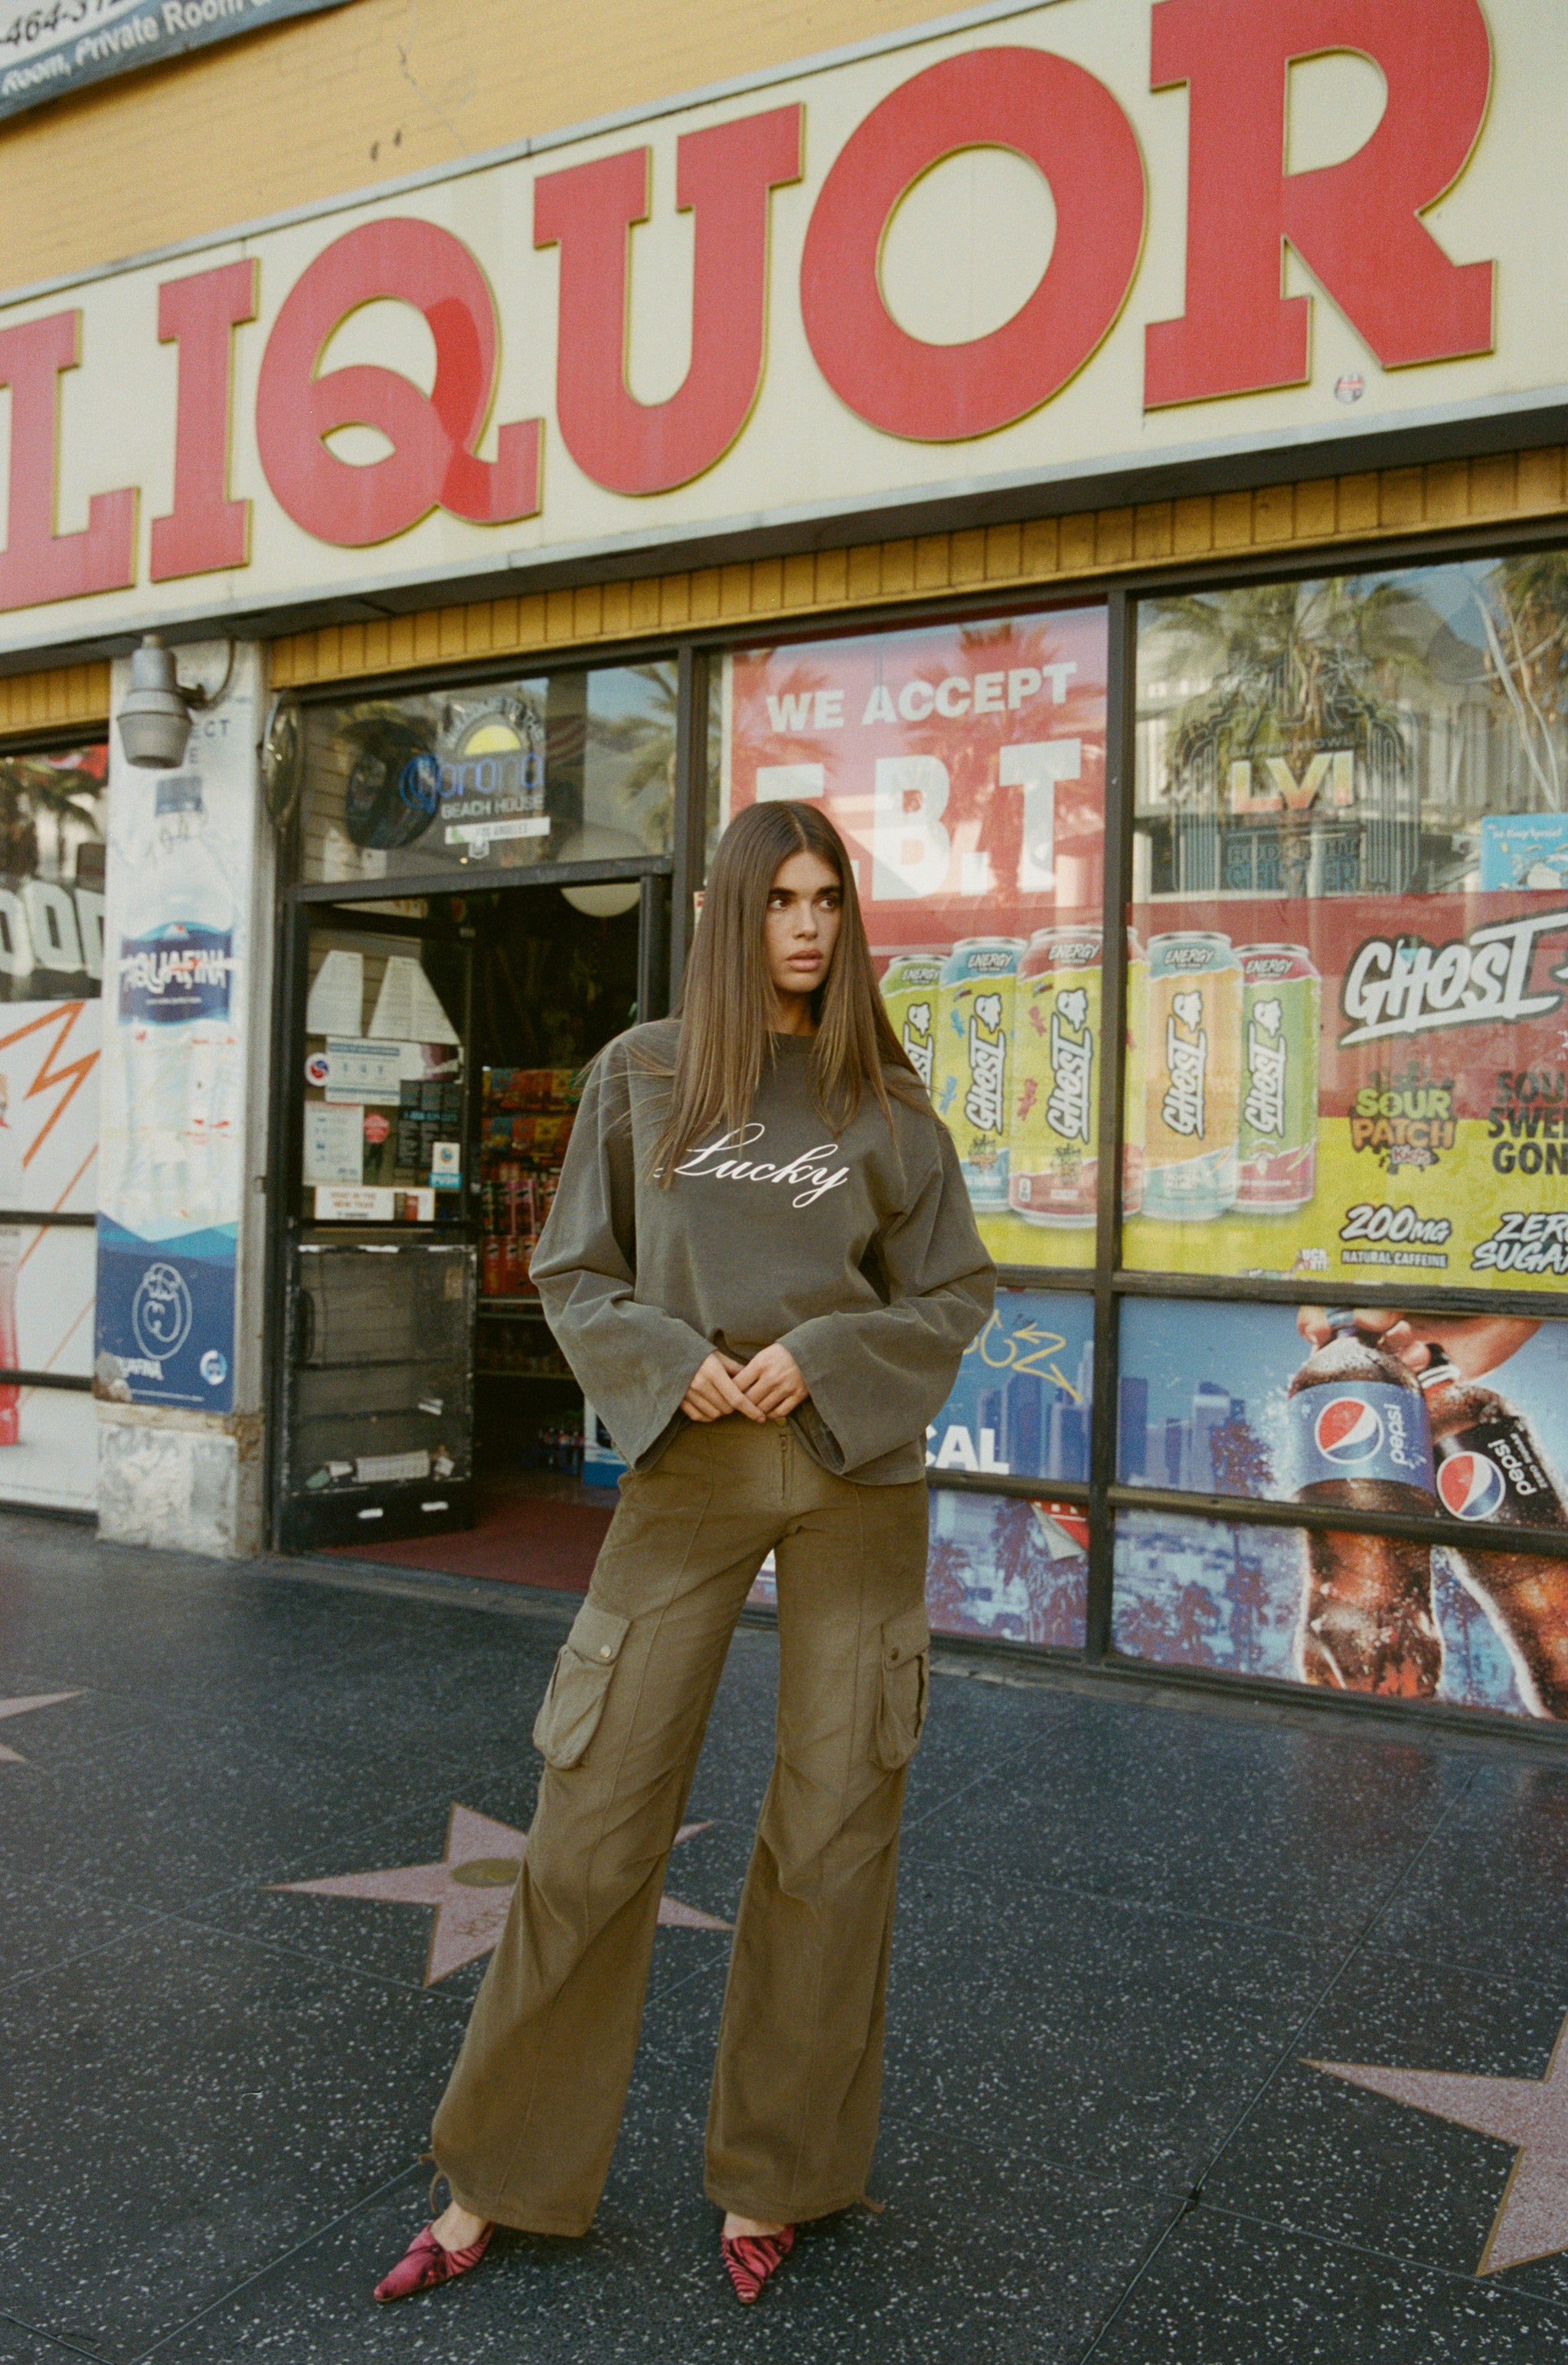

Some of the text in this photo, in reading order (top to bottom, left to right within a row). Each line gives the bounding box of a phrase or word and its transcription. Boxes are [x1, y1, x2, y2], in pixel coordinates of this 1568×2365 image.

[162, 0, 245, 34] Room
[0, 0, 1498, 611] LIQUOR
[766, 661, 1077, 733] WE ACCEPT
[440, 794, 544, 820] BEACH HOUSE
[1230, 750, 1354, 815] LVI
[756, 737, 1083, 901] .B.T
[1341, 912, 1568, 1045] GHOST
[965, 1016, 1007, 1135] GHOST
[1046, 1011, 1093, 1145] GHOST
[1162, 1014, 1207, 1140] GHOST
[1243, 1020, 1287, 1138] GHOST
[1354, 1086, 1453, 1120] SOUR
[652, 1122, 850, 1209] Lucky
[1351, 1117, 1456, 1151] PATCH
[1492, 1141, 1568, 1175] GON
[1341, 1249, 1393, 1265] NATURAL
[1393, 1251, 1447, 1268] CAFFEINE
[1493, 1212, 1568, 1243] ZER
[1383, 1403, 1410, 1467] pepsi
[1488, 1439, 1537, 1497] pepsi
